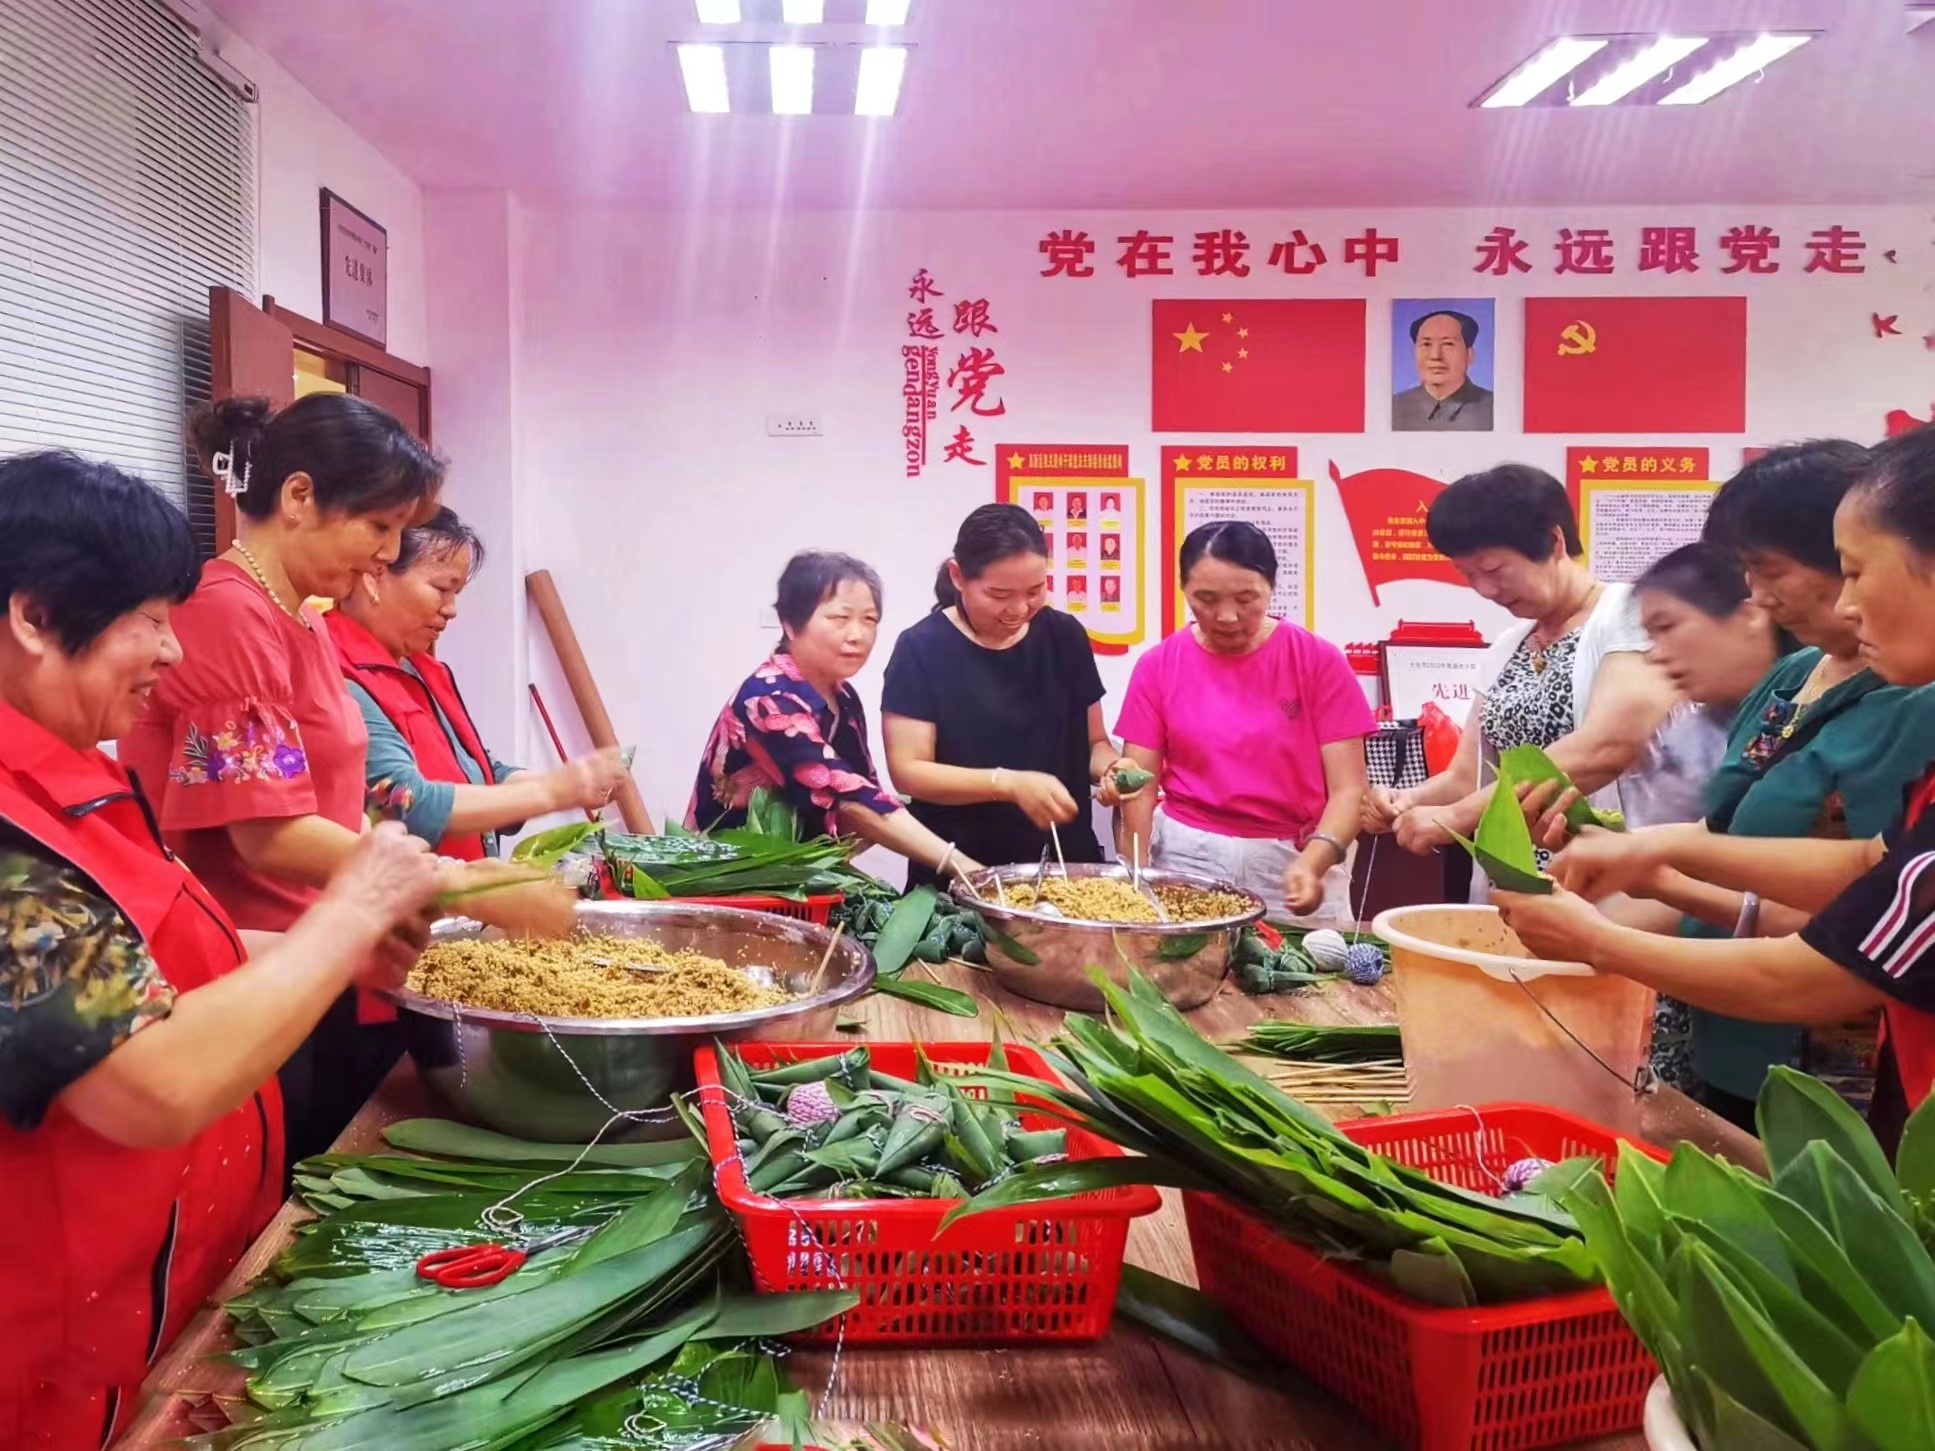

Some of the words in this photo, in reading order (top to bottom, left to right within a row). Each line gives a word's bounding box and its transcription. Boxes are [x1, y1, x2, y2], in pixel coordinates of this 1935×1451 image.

[1039, 228, 1400, 278] 党在我心中
[1473, 225, 1867, 275] 永远跟党走
[944, 298, 1006, 466] 跟党走
[1196, 454, 1286, 471] 党员的权利
[1602, 455, 1697, 473] 党员的义务
